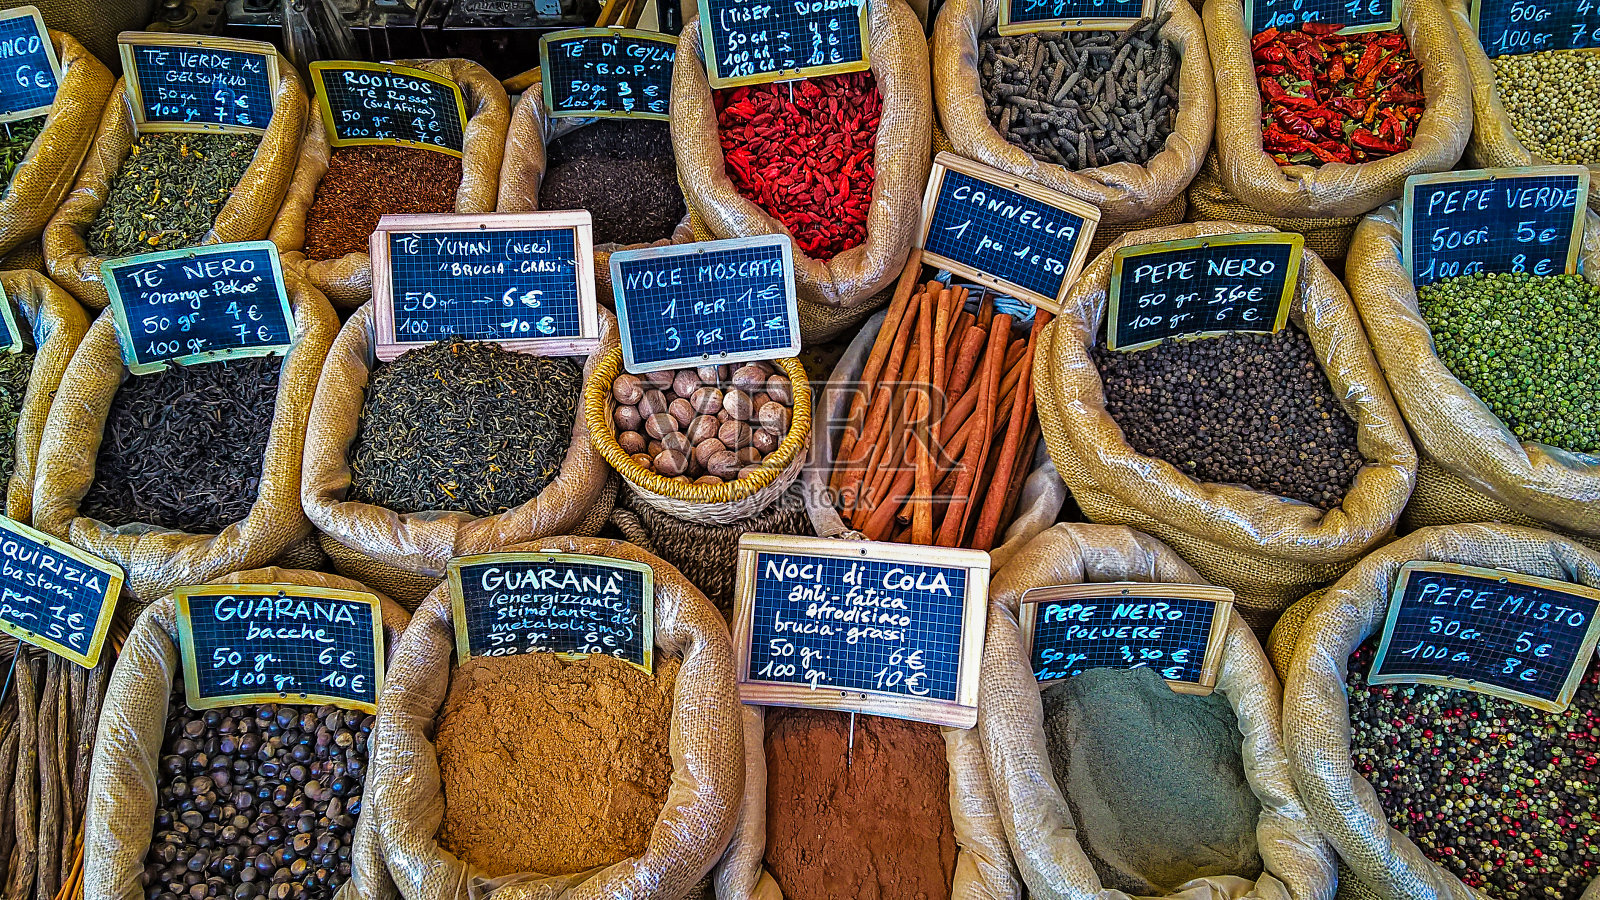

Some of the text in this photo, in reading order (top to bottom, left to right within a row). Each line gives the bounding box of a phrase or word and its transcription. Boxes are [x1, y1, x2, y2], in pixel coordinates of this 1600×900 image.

[0, 36, 40, 58] NCO
[180, 52, 231, 69] VERDE
[16, 65, 51, 88] 6 €
[342, 71, 432, 94] ROOIBOS
[213, 107, 228, 122] 7
[1428, 186, 1582, 216] PEPE VERDE
[953, 186, 1075, 241] CANNELLA
[945, 220, 971, 239] 1
[1517, 221, 1557, 243] 5 €
[182, 258, 255, 280] NERO
[626, 259, 783, 290] NOCE MOSCATA
[1134, 257, 1275, 283] PEPE NERO
[1512, 254, 1553, 275] 8 €
[403, 286, 543, 312] 50 6 €
[661, 298, 676, 319] 1
[694, 298, 726, 316] PER
[1138, 293, 1166, 308] 50
[142, 315, 171, 334] 50
[225, 301, 242, 321] 4
[247, 304, 263, 321] €
[400, 316, 556, 334] 100 10 €
[1129, 315, 1163, 330] 100
[1216, 308, 1233, 321] 6
[145, 339, 180, 357] 100
[231, 323, 251, 345] 7
[257, 326, 273, 342] €
[665, 316, 785, 352] 3 PER 2 €
[765, 558, 823, 583] NOCI
[842, 562, 863, 586] di
[2, 588, 41, 604] per
[1417, 583, 1585, 628] PEPE MISTO
[497, 605, 638, 626] stimolante del
[1044, 602, 1183, 624] PEPE NERO
[246, 621, 335, 643] bacche
[487, 632, 517, 646] 50
[602, 635, 617, 647] €
[769, 638, 794, 657] 50
[1515, 631, 1552, 658] 5 €
[213, 647, 242, 668] 50
[318, 647, 336, 665] 6
[339, 651, 357, 668] €
[757, 660, 796, 678] 100
[1502, 657, 1538, 682] 8 €
[218, 670, 266, 688] 100
[320, 671, 346, 688] 10
[351, 675, 366, 693] €
